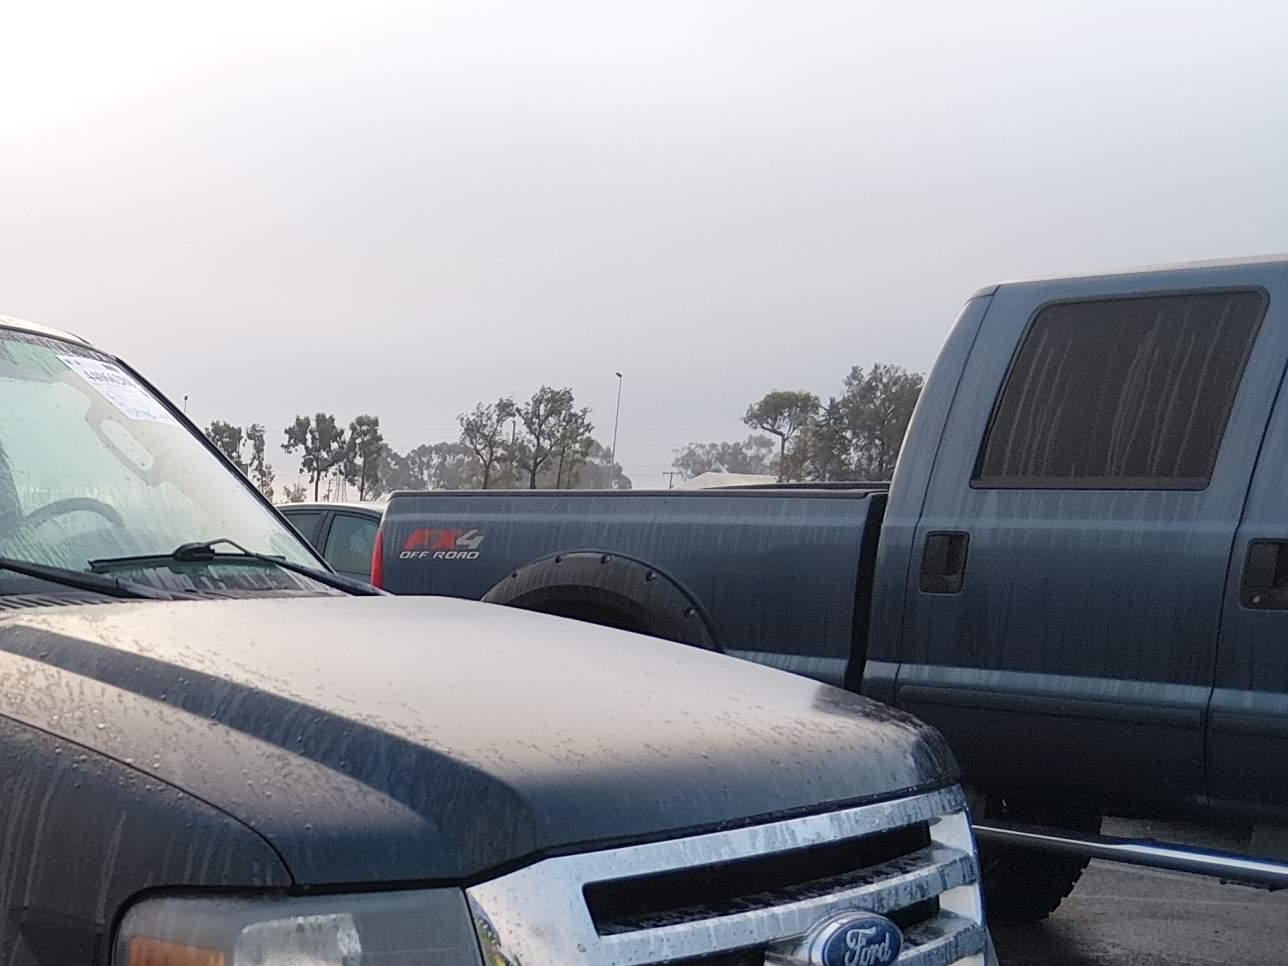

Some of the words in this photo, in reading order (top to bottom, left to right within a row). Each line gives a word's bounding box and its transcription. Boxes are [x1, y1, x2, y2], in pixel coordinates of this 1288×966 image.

[402, 528, 485, 550] FX4
[399, 551, 428, 559] OFF
[432, 551, 480, 559] ROAD
